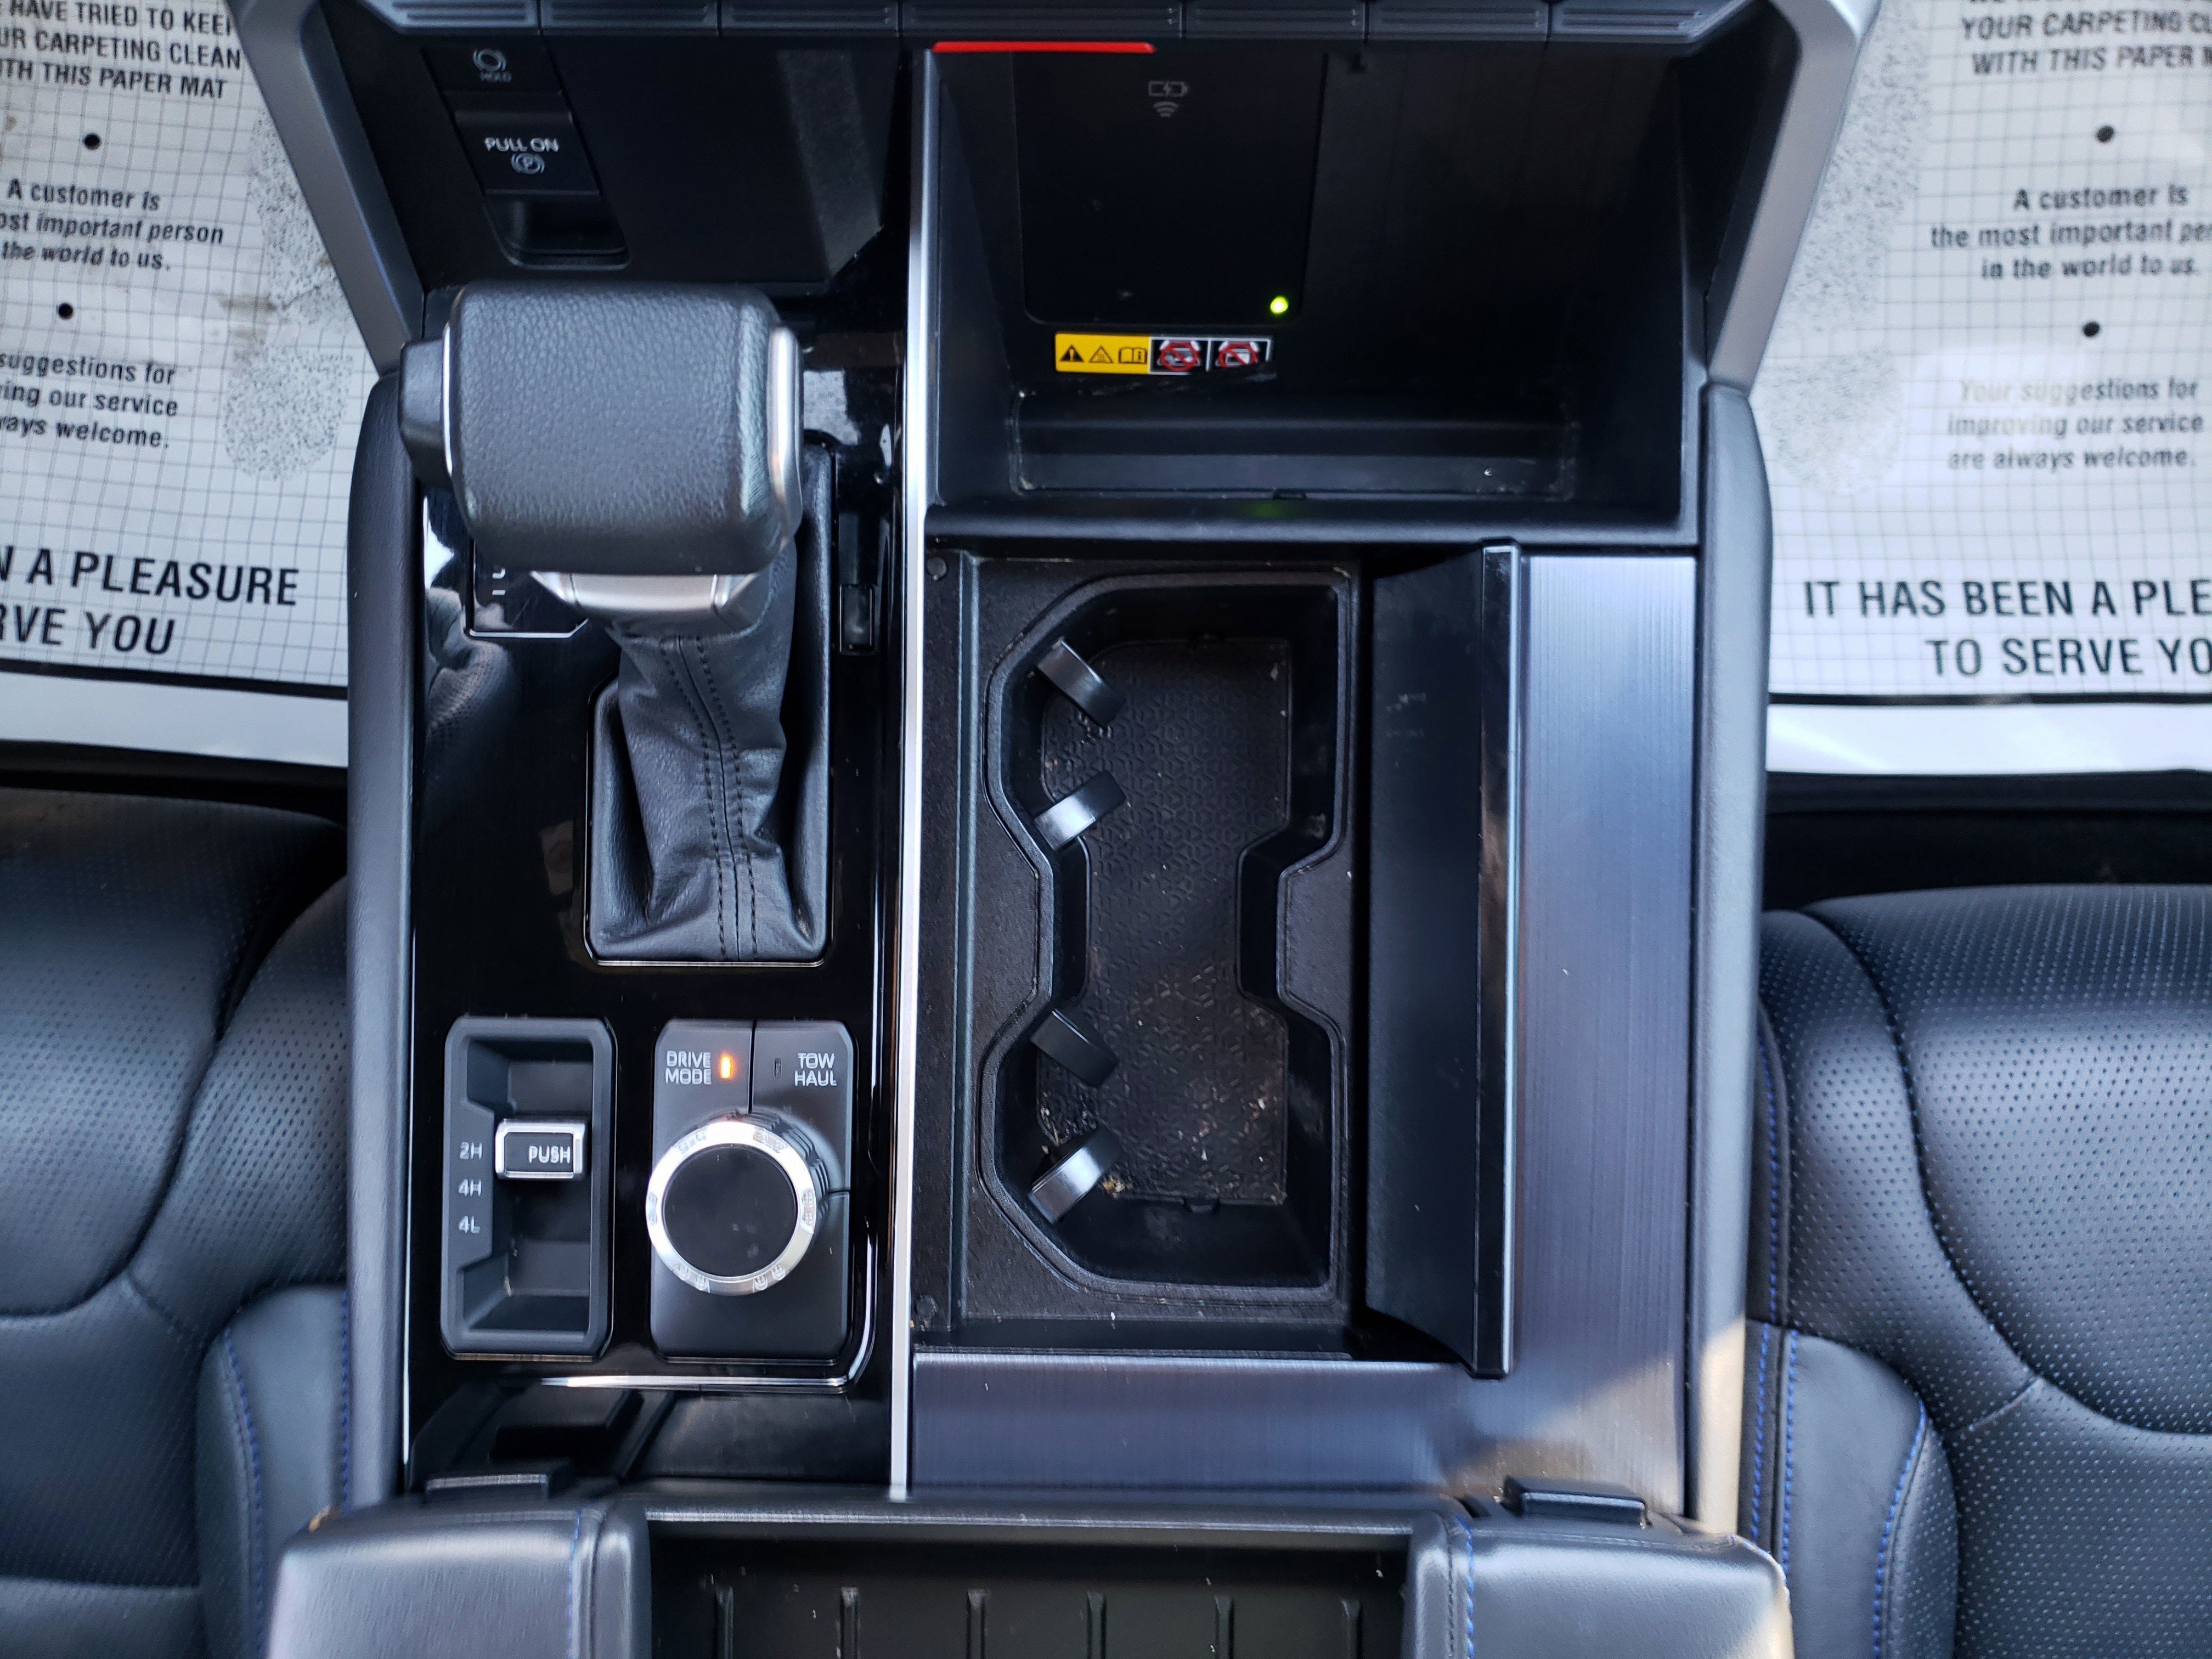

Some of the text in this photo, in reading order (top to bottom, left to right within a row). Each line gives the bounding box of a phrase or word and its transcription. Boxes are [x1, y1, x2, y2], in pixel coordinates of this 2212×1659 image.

[10, 0, 66, 21] HAVE
[75, 2, 137, 26] TRIED
[146, 7, 173, 31] TO
[1962, 14, 2032, 40] YOUR
[2042, 8, 2182, 36] CARPETING
[35, 30, 160, 62] CARPETING
[170, 42, 240, 70] CLEAN
[1972, 49, 2038, 75] WITH
[2050, 46, 2107, 71] THIS
[2116, 44, 2193, 69] PAPER
[43, 61, 91, 86] THIS
[100, 67, 171, 94] PAPER
[180, 75, 228, 99] MAT
[484, 137, 559, 153] PULL ON
[8, 179, 160, 211] A customer is
[2013, 183, 2188, 212] A customer is
[37, 211, 143, 238] important
[147, 223, 223, 244] person
[1931, 223, 1969, 247] the
[1978, 223, 2039, 246] most
[2050, 219, 2172, 247] important
[2, 240, 170, 271] the world to us.
[1981, 257, 2002, 279] in
[2013, 256, 2051, 279] the
[2061, 252, 2131, 278] world
[2141, 252, 2162, 276] to
[146, 362, 175, 385] for
[49, 389, 86, 408] our
[94, 393, 178, 417] service
[1961, 376, 2198, 407] Your suggestions for
[56, 421, 169, 449] welcome.
[1948, 413, 2204, 439] improving our service
[1948, 451, 1984, 470] are
[1994, 446, 2075, 473] always
[27, 548, 52, 585] A
[71, 551, 300, 606] PLEASURE
[1804, 580, 1840, 618] IT
[1859, 580, 1946, 617] HAS
[1962, 580, 2074, 617] BEEN
[2091, 580, 2117, 616] A
[86, 611, 175, 655] YOU
[1926, 639, 1983, 677] TO
[2001, 637, 2143, 676] SERVE
[666, 1050, 711, 1069] DRIVE
[798, 1052, 836, 1069] TOW
[665, 1068, 712, 1085] MODE
[794, 1070, 837, 1086] HAUL
[459, 1142, 483, 1160] 2H
[528, 1146, 571, 1164] PUSH
[458, 1179, 482, 1197] 4H
[458, 1215, 481, 1234] 4L
